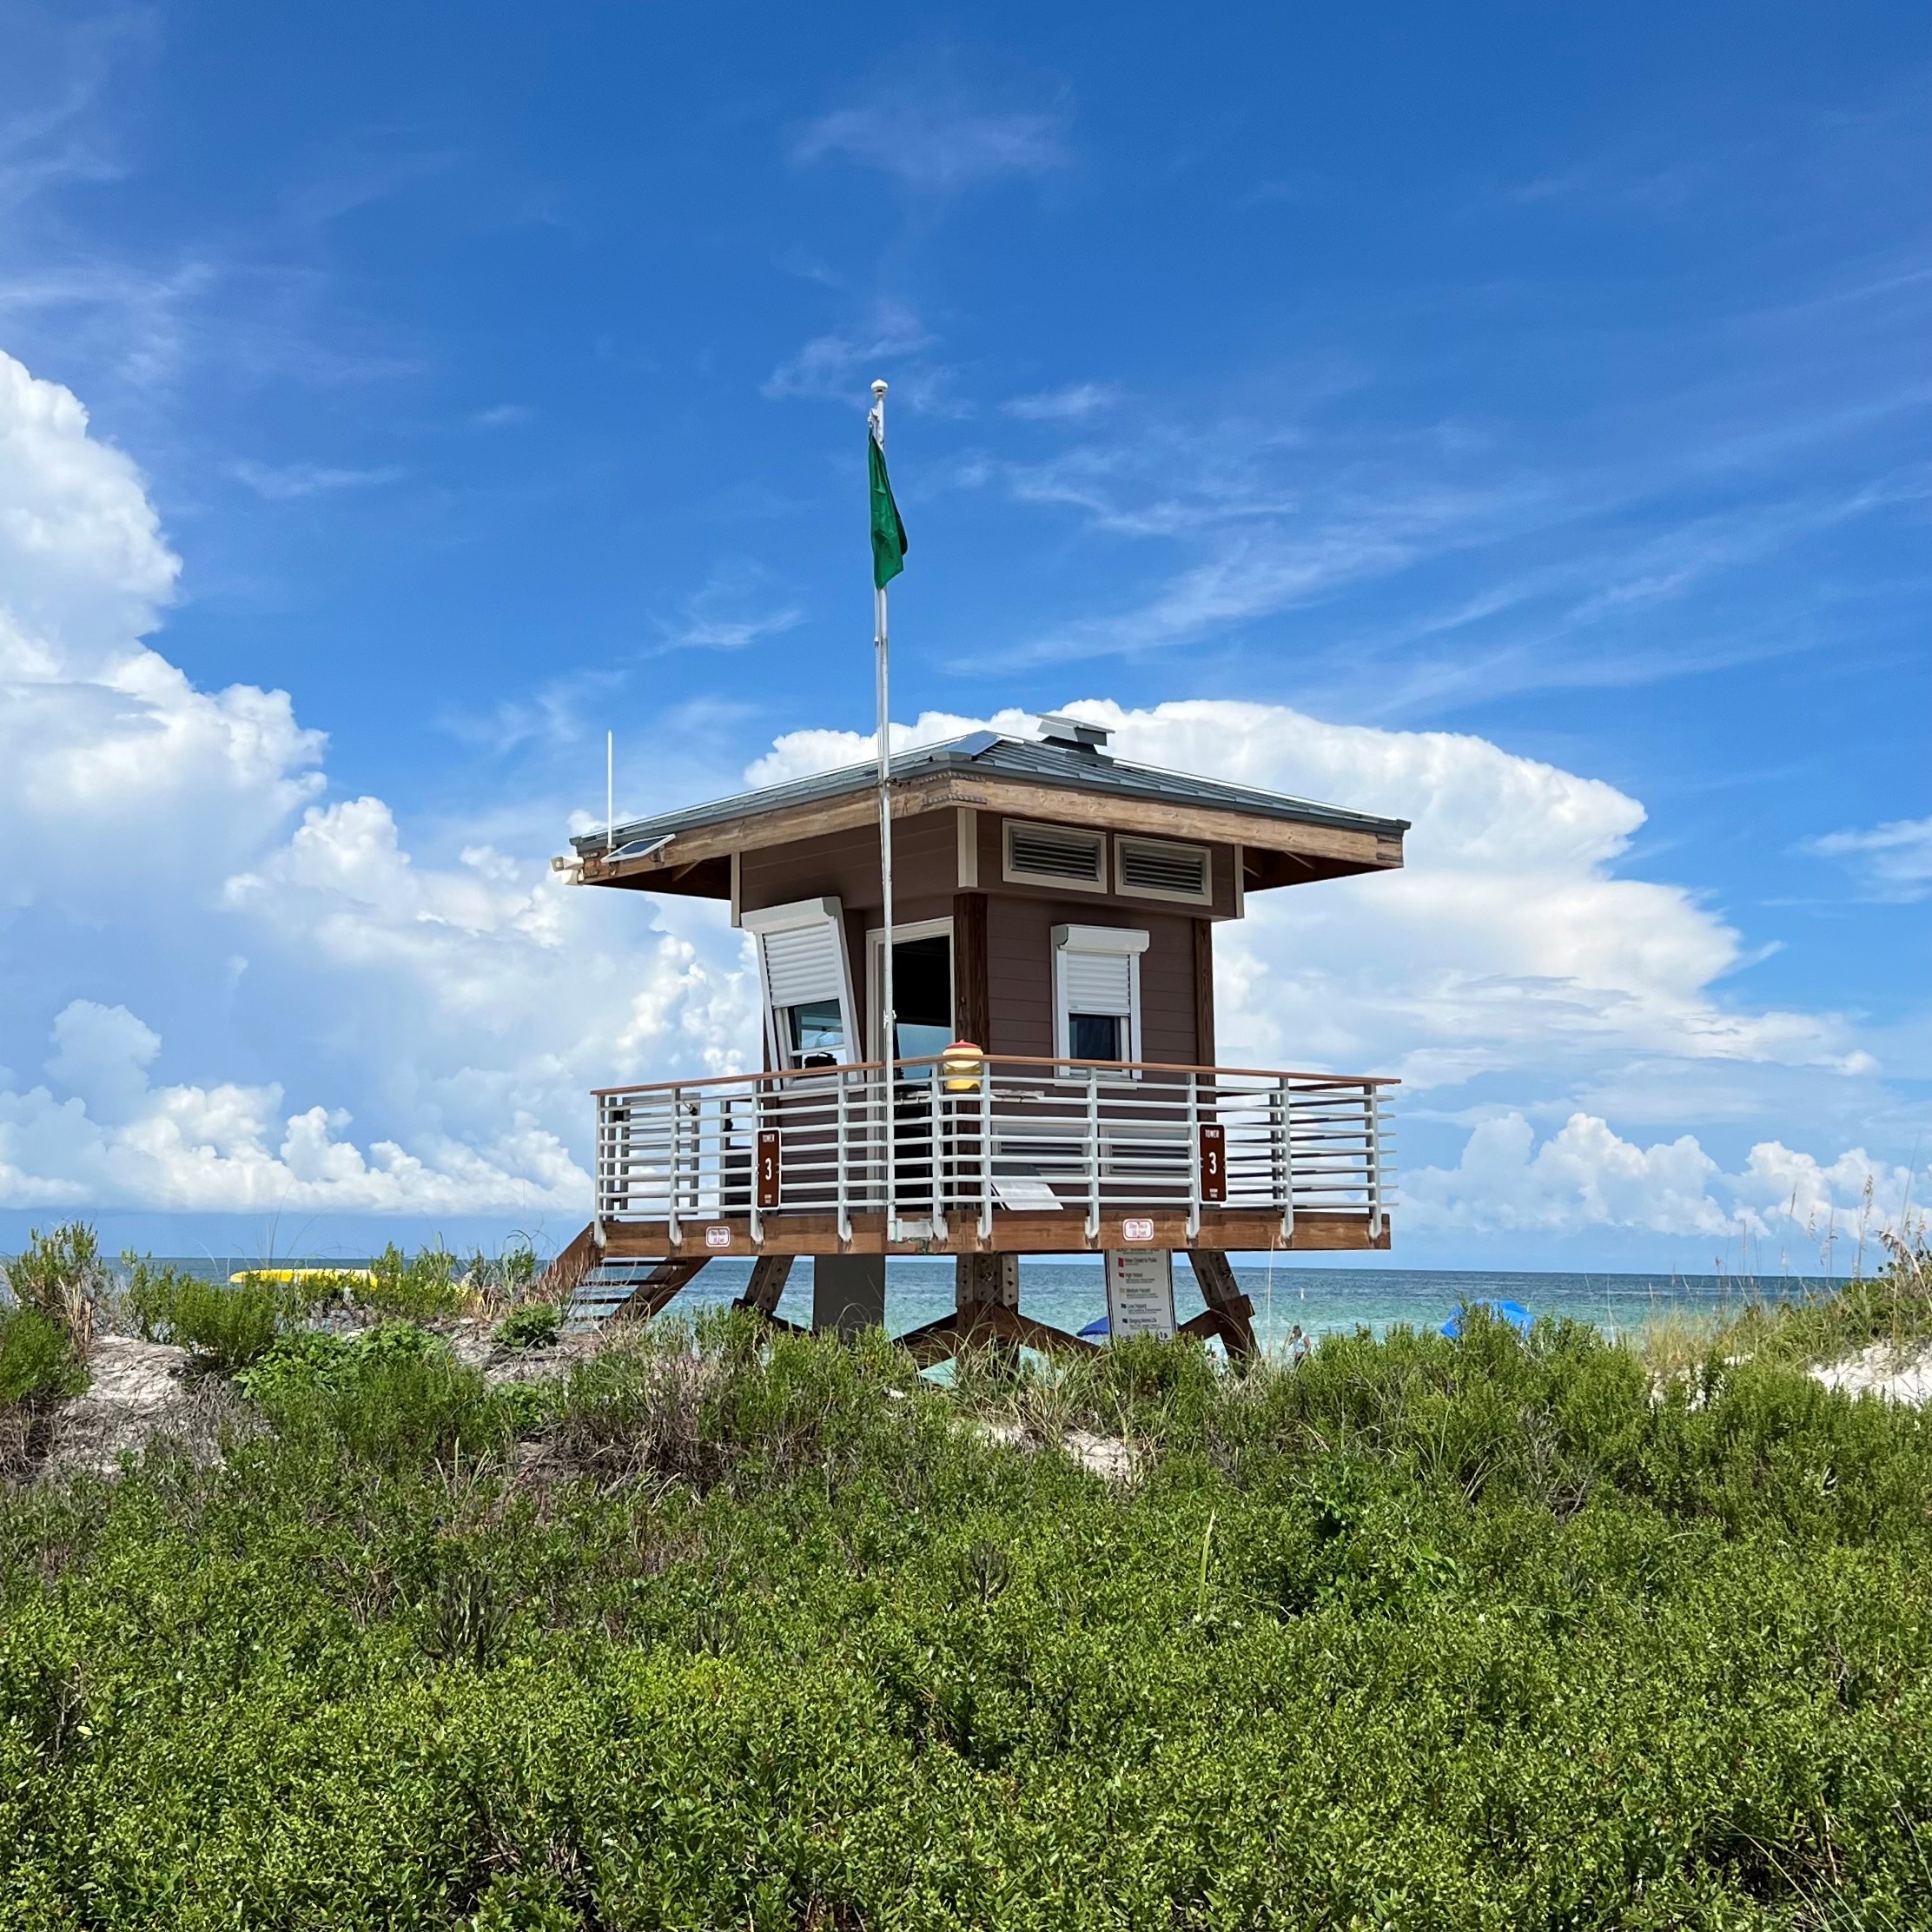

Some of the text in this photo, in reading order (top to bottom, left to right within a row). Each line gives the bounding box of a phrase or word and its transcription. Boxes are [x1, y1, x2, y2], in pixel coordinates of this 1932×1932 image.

[1205, 1129, 1220, 1138] TOWER
[764, 1157, 772, 1181] 3
[1208, 1151, 1216, 1174] 3
